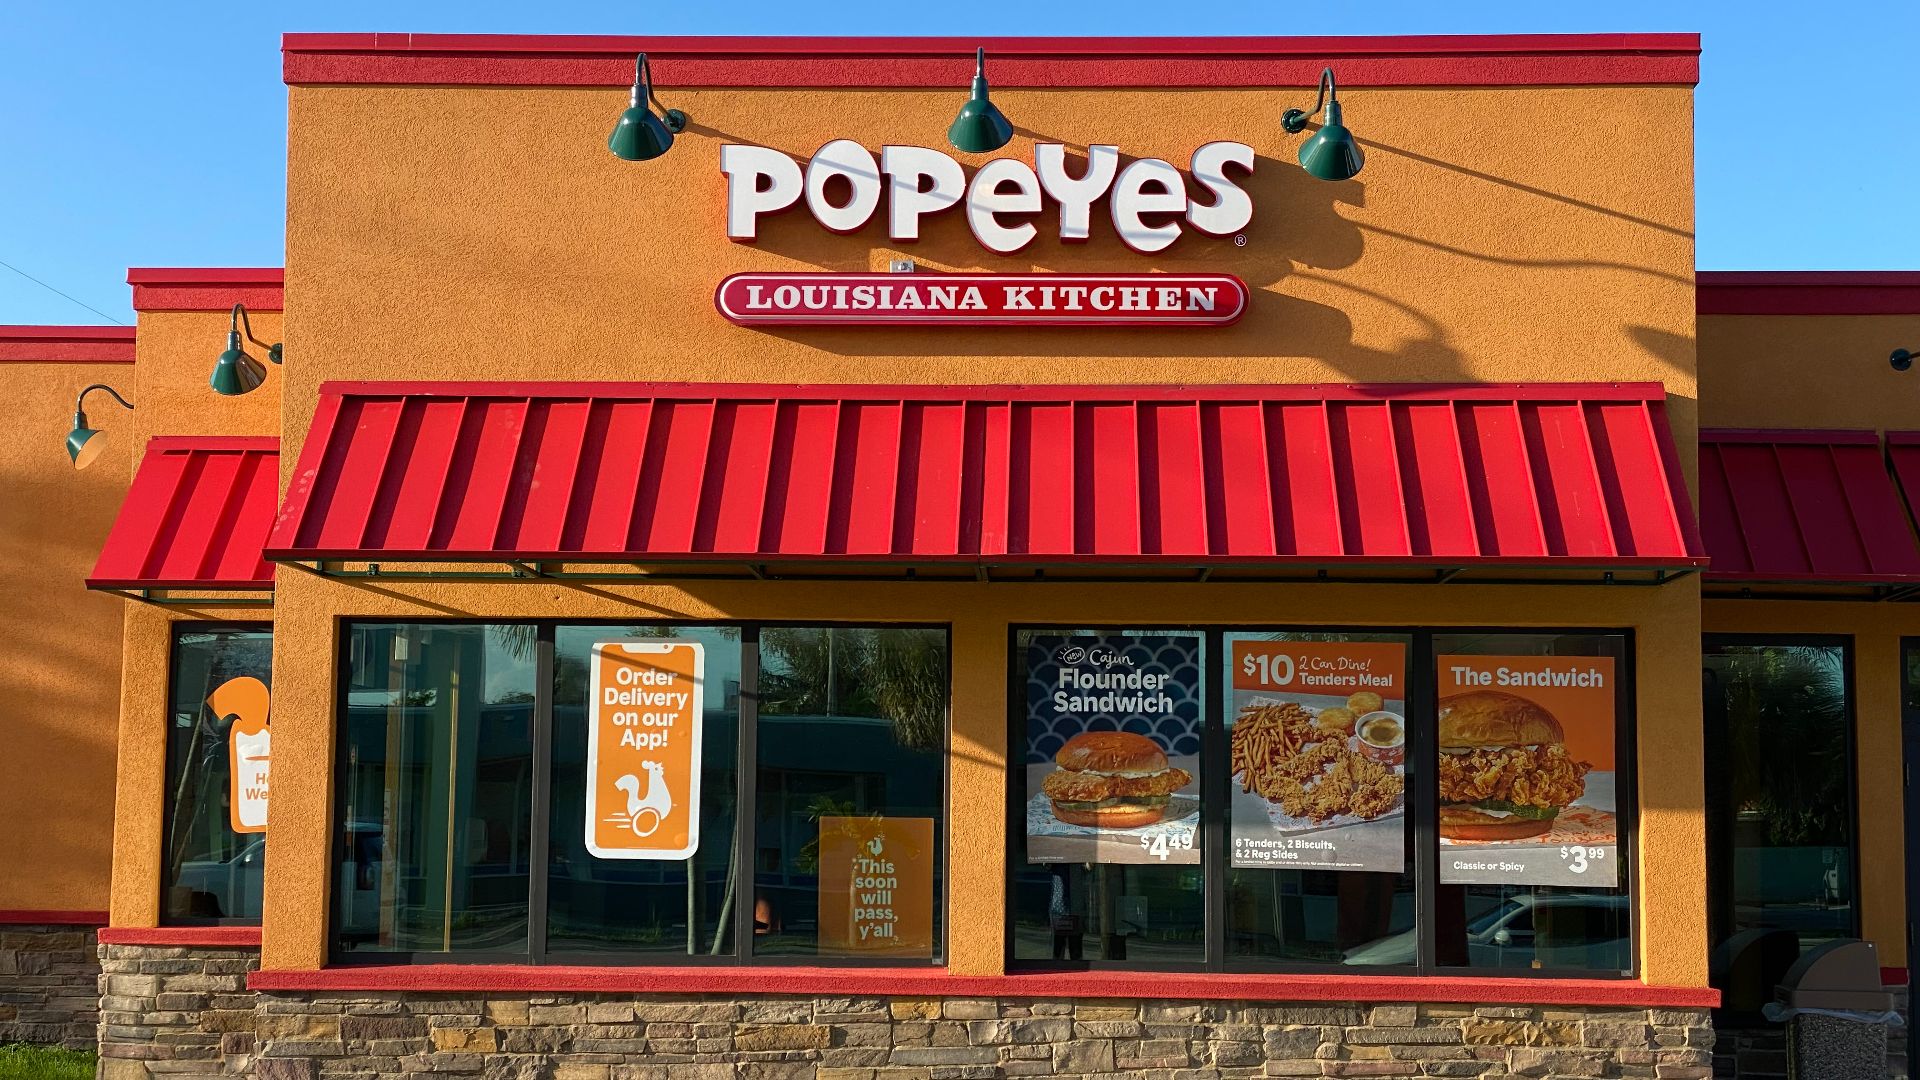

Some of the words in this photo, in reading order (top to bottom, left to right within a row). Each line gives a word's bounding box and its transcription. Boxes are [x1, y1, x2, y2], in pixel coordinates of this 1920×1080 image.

[745, 285, 988, 311] LOUISIANA
[1002, 286, 1218, 312] KITCHEN
[1089, 649, 1135, 669] Cajun
[1311, 657, 1337, 670] Can
[1337, 656, 1372, 672] Dine!
[615, 667, 678, 686] Order
[1243, 653, 1295, 686] $10
[1450, 666, 1492, 686] The
[1496, 667, 1603, 688] Sandwich
[1058, 668, 1170, 690] Flounder
[1298, 672, 1357, 686] Tenders
[1358, 673, 1393, 687] Meal
[604, 687, 689, 711] Delivery
[1053, 691, 1173, 713] Sandwich
[612, 712, 638, 727] on
[642, 712, 680, 727] our
[620, 728, 668, 751] App!
[1235, 838, 1242, 848] 6
[1243, 838, 1286, 850] Tenders,
[1287, 839, 1293, 849] 2
[1295, 840, 1336, 851] Biscuits,
[1235, 849, 1243, 858] &
[1244, 849, 1251, 859] 2
[1251, 849, 1271, 861] Reg
[1272, 850, 1299, 860] Sides
[858, 858, 895, 874] This
[1453, 861, 1486, 871] Classic
[1487, 863, 1498, 871] or
[1499, 862, 1525, 873] Spicy
[855, 877, 897, 889] soon
[860, 890, 892, 905] will
[854, 907, 899, 923] pass,
